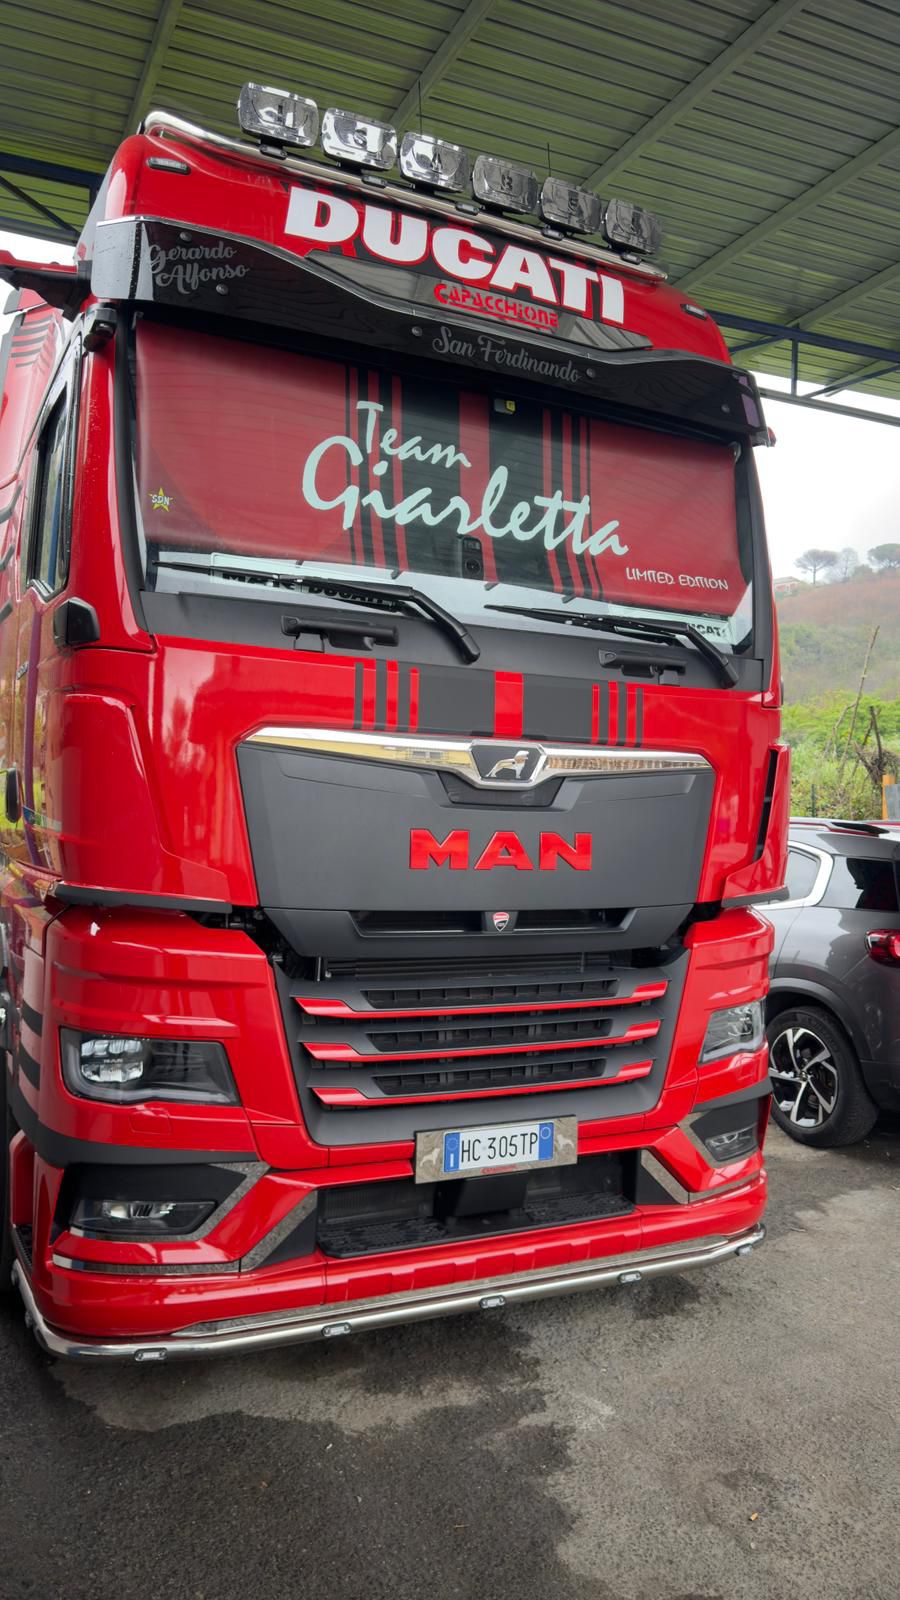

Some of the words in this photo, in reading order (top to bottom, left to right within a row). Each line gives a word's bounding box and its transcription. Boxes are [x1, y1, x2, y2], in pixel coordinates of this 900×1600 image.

[149, 241, 237, 274] Gerardo
[284, 186, 624, 324] DUCATI
[155, 262, 249, 295] Alfonso
[432, 326, 475, 358] San
[478, 335, 582, 383] Ferdinando
[356, 400, 472, 469] Team
[302, 435, 629, 556] Giarletta
[626, 567, 675, 585] LIMITED
[679, 574, 729, 591] EDITION
[409, 828, 593, 870] MAN
[461, 1138, 481, 1163] HC
